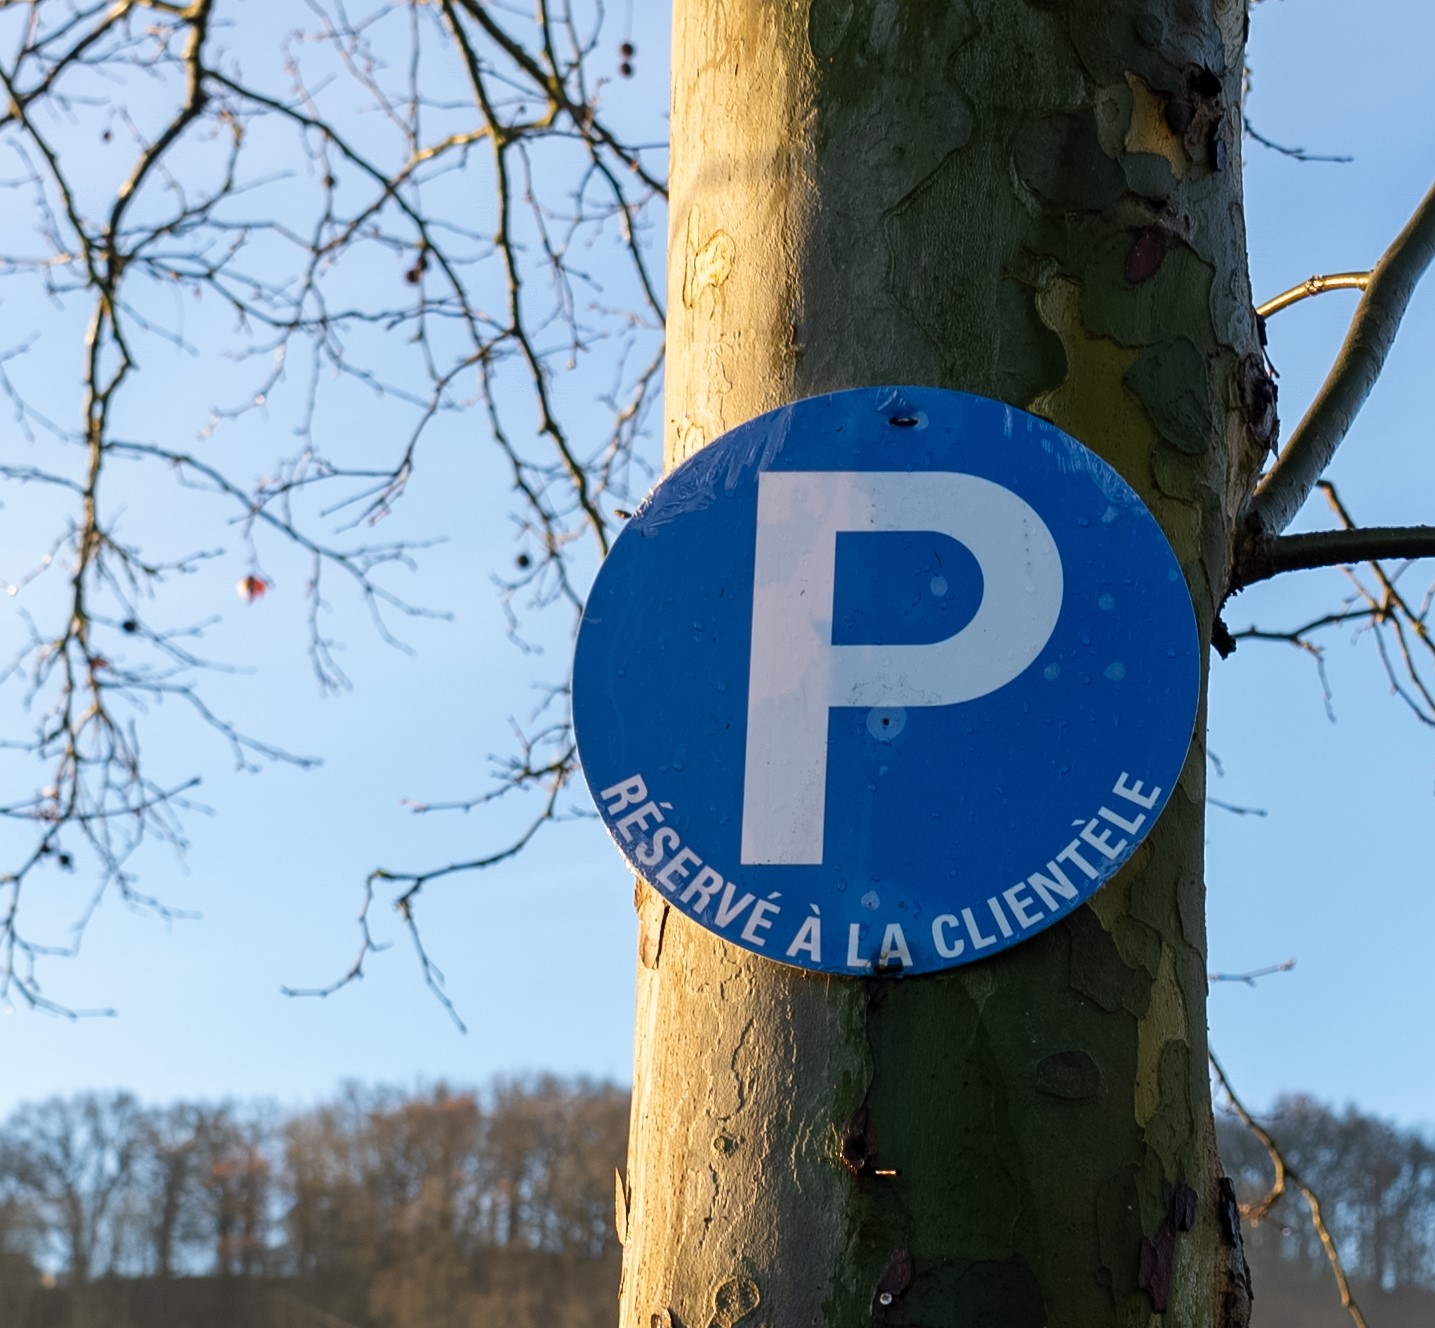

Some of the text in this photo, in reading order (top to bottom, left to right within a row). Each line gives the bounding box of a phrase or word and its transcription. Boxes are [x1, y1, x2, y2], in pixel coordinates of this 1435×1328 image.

[740, 471, 1064, 865] P
[600, 771, 1162, 967] RÉSERVÉ À LA CLIENTÈLE
